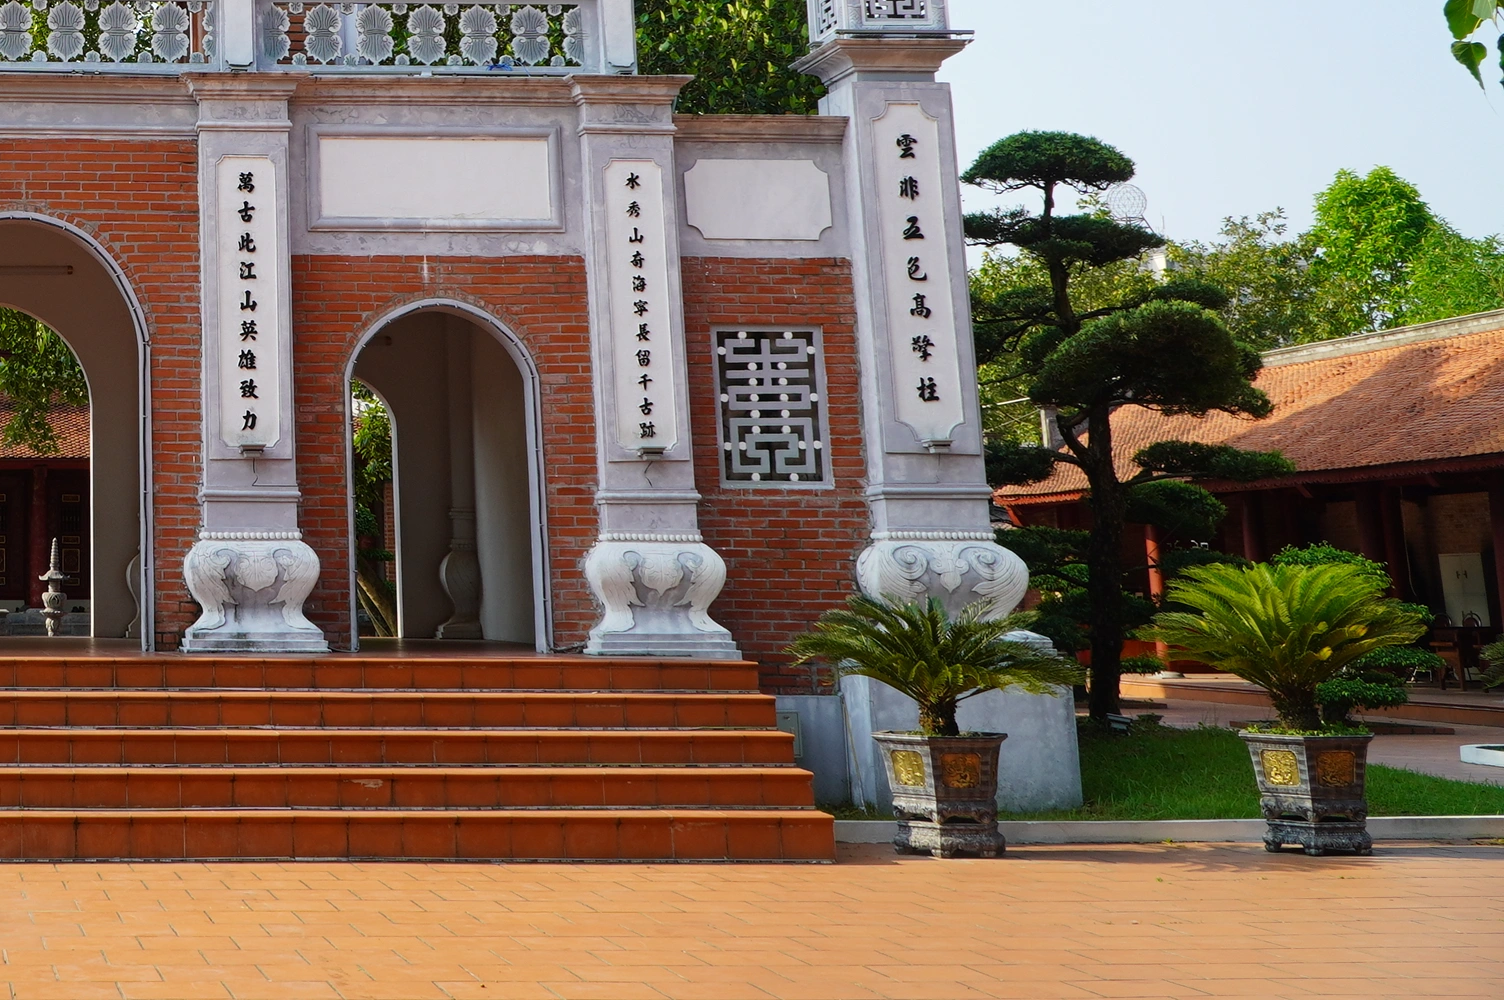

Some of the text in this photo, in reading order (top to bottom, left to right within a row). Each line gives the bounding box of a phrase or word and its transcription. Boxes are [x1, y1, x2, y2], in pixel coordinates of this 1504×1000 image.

[237, 171, 260, 432] 萬古此江山英雄致力
